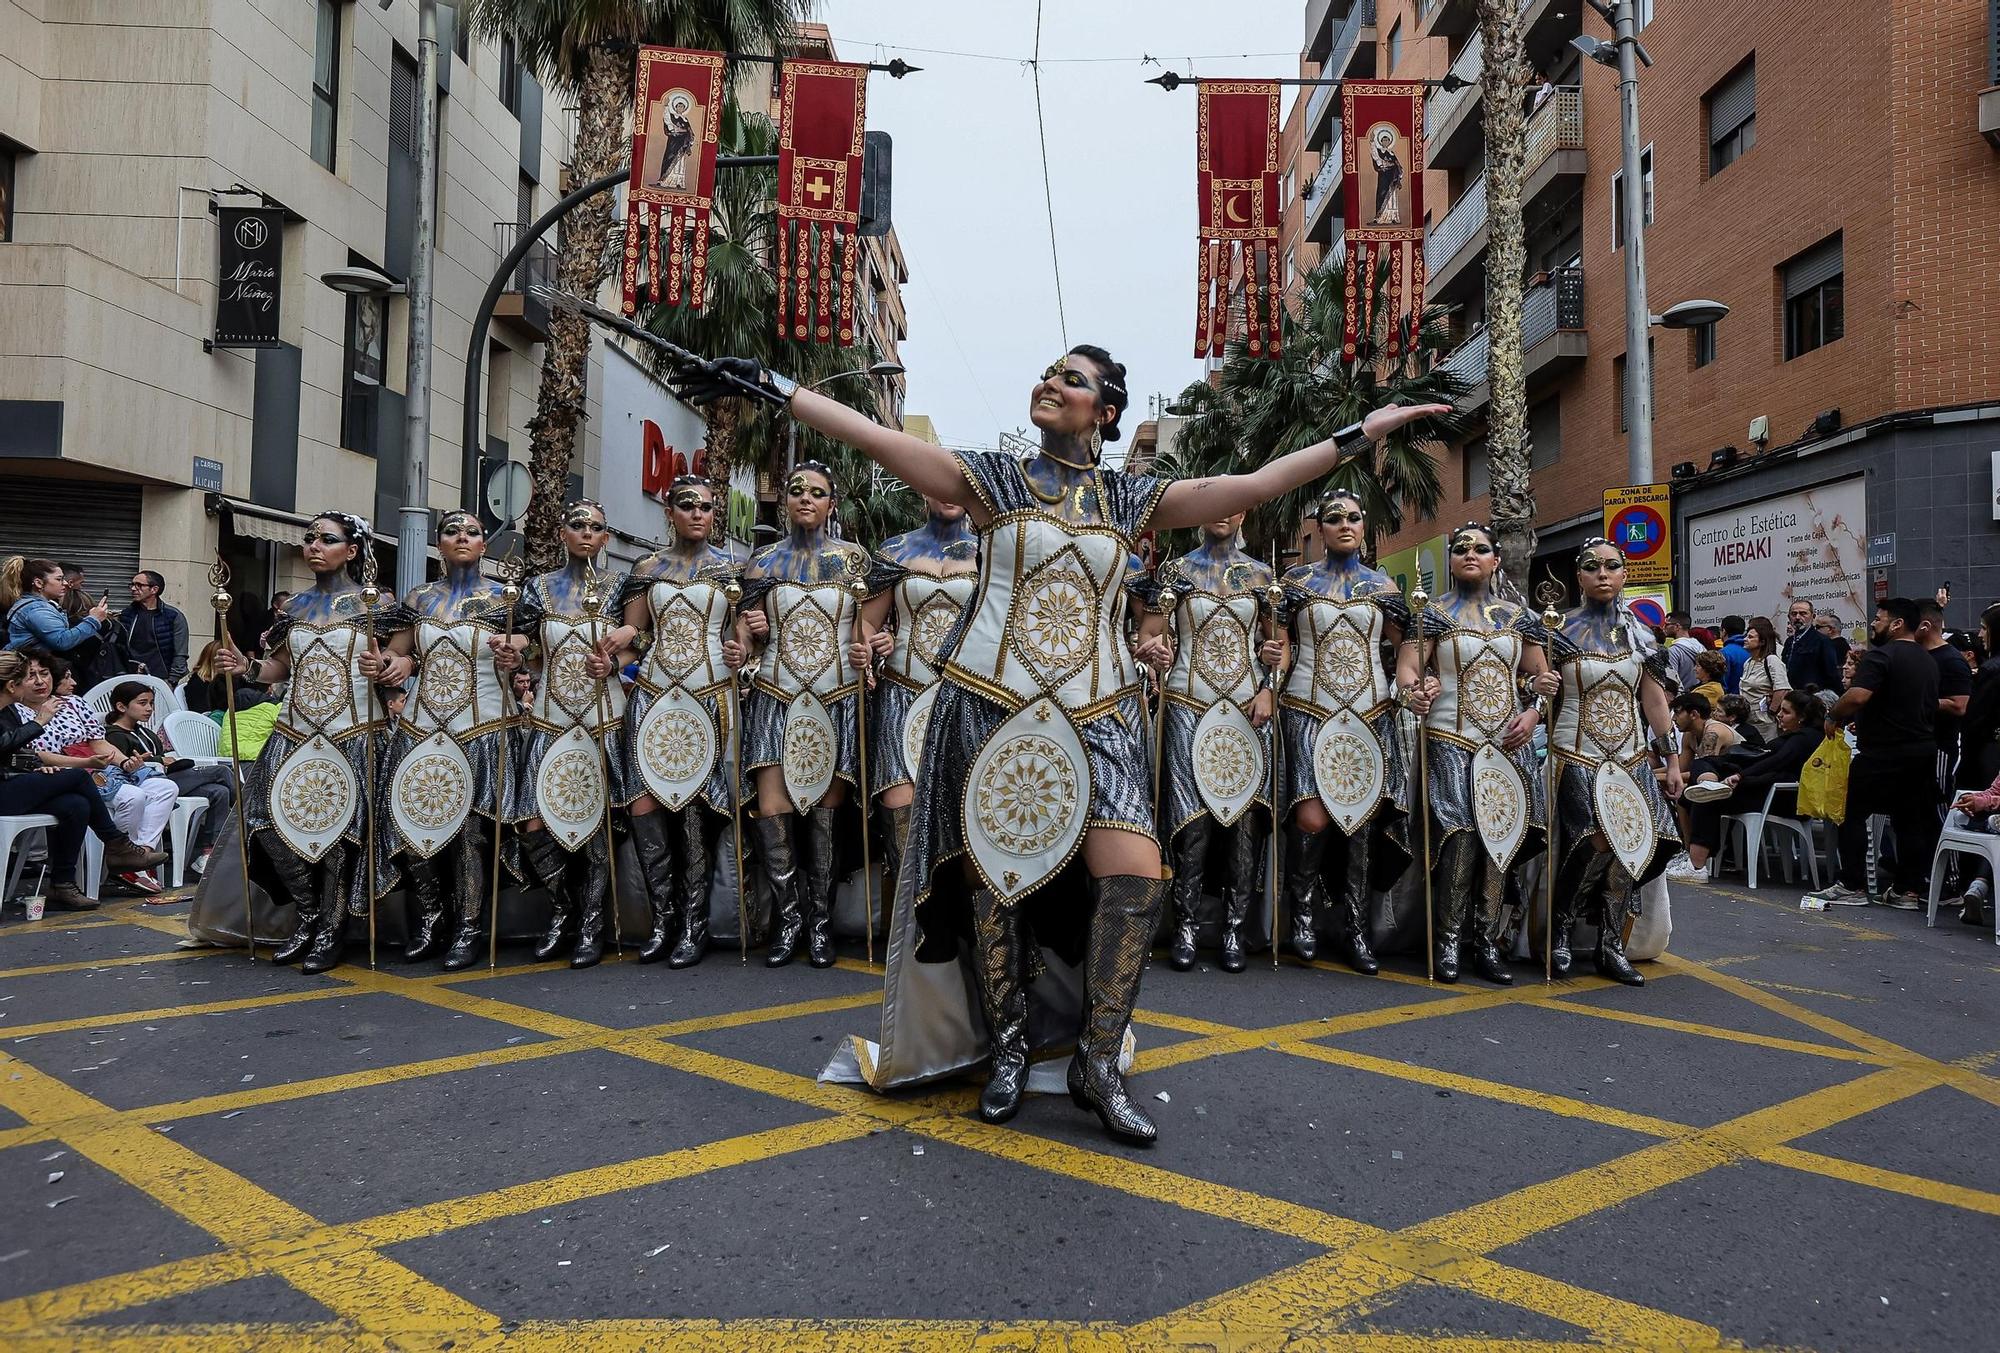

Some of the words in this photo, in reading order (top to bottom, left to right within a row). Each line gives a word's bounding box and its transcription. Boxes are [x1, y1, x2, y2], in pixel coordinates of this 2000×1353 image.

[221, 260, 275, 281] María
[220, 282, 274, 311] Núñez
[200, 460, 220, 471] CARRER
[195, 476, 220, 491] ALICANTE
[1634, 494, 1669, 504] DESCARGA
[1693, 529, 1729, 546] Centro
[1733, 519, 1746, 539] de
[1750, 512, 1797, 535] Estética
[1790, 535, 1803, 543] Tinte
[1804, 533, 1811, 541] de
[1812, 531, 1826, 541] Cejas
[1875, 536, 1891, 545] CALLE
[1714, 537, 1772, 567] MERAKI
[1790, 547, 1818, 558] Maquillaje
[1868, 553, 1893, 566] ALICANTE
[1790, 564, 1812, 573] Masajes
[1813, 559, 1840, 570] Relajantes
[1718, 575, 1727, 583] Cera
[1791, 580, 1810, 588] Masaje
[1810, 576, 1830, 586] Piedras
[1740, 584, 1758, 593] Pulsada
[1826, 590, 1848, 599] Faciales
